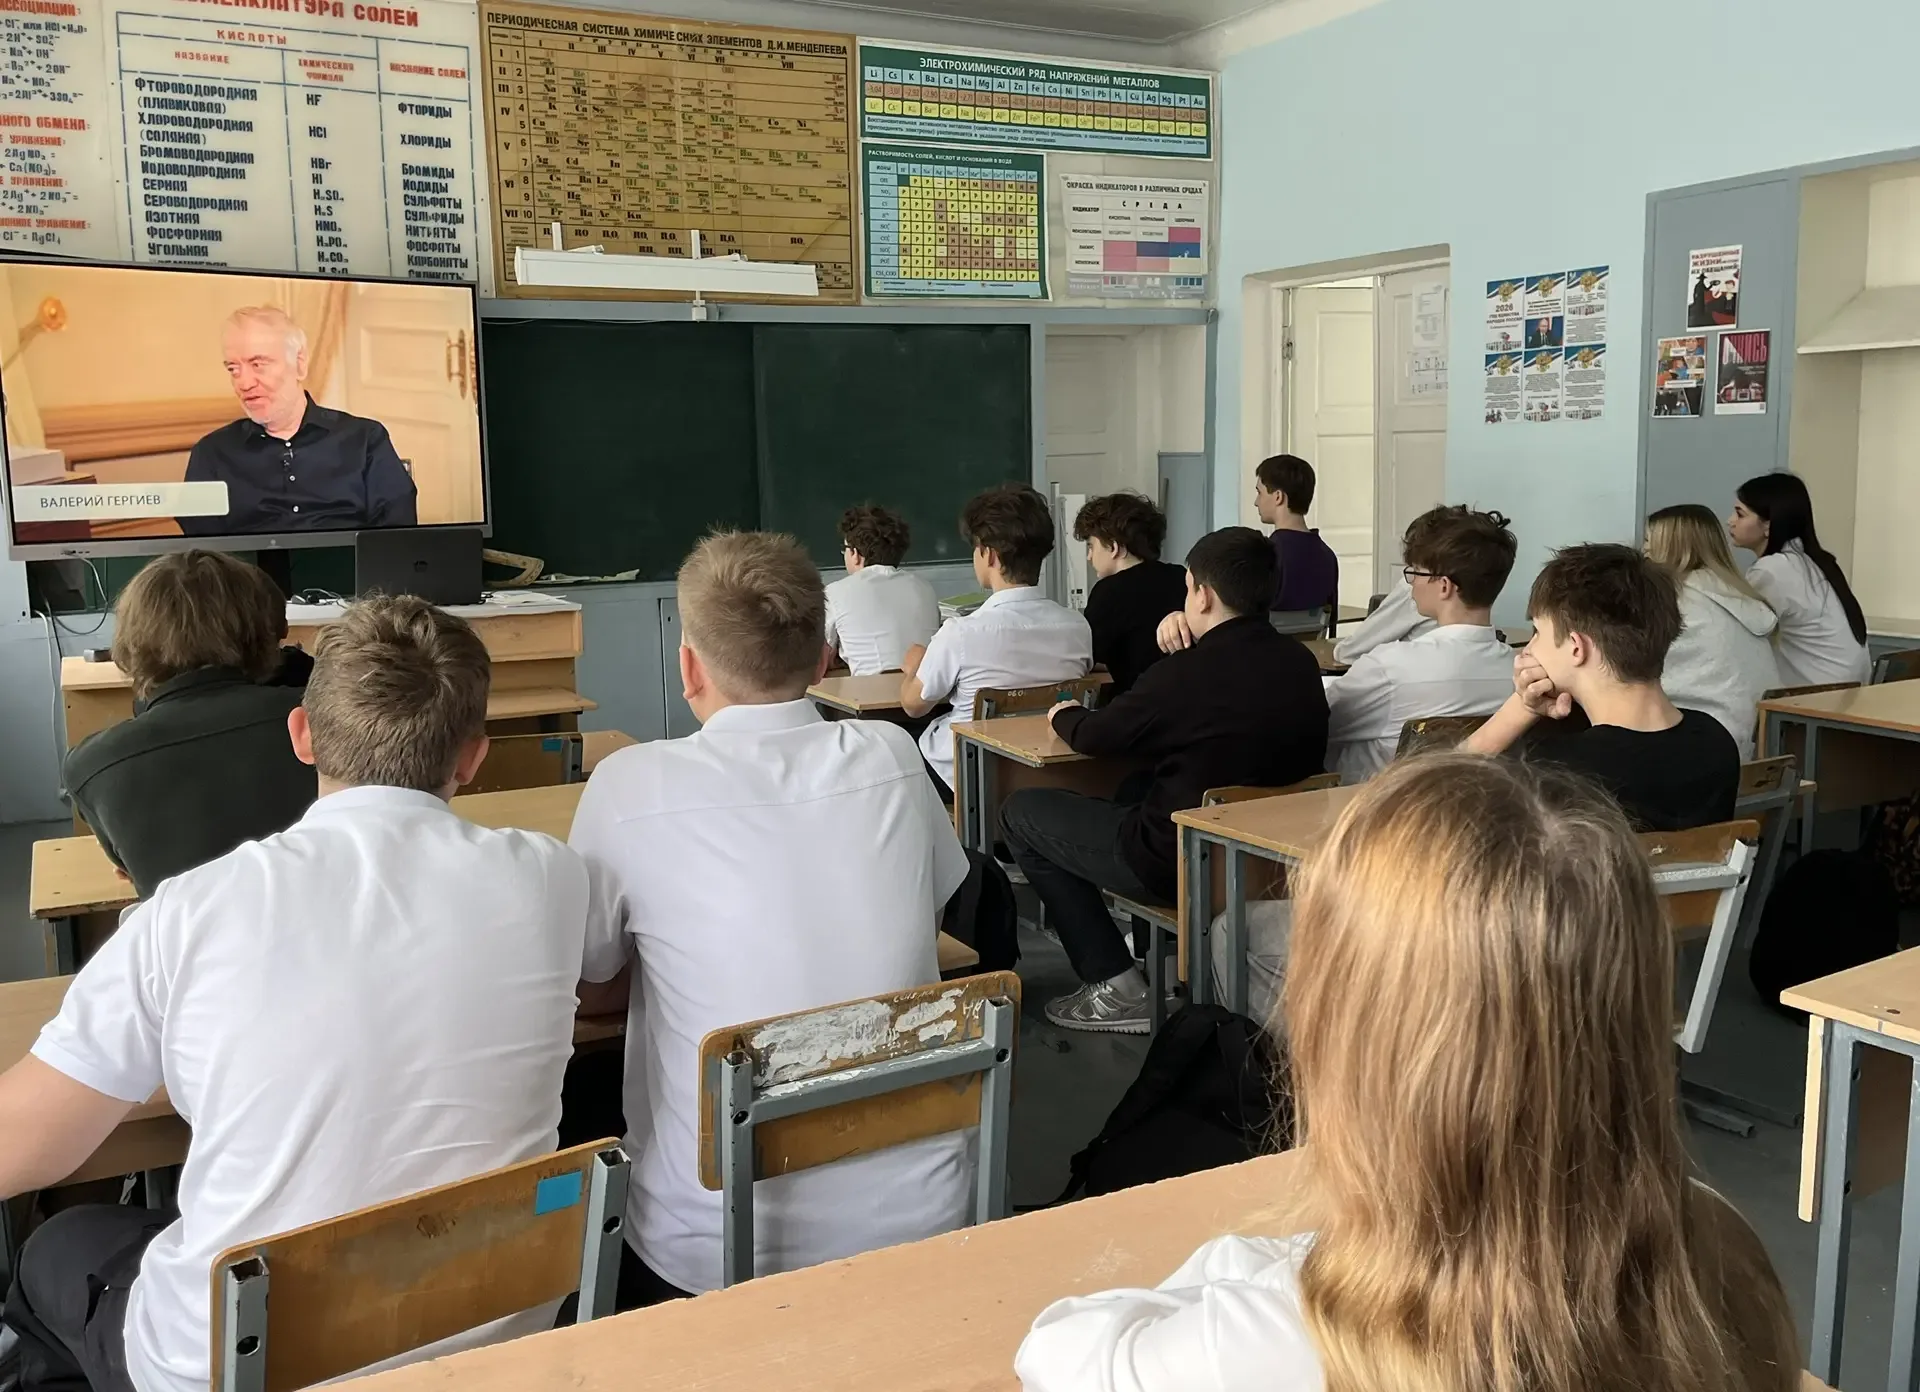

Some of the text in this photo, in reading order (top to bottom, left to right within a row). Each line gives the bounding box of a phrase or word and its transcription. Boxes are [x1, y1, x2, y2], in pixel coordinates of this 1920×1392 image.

[353, 4, 419, 27] СОЛЕЙ
[217, 30, 287, 45] КИСЛОТЫ
[582, 22, 630, 37] СИСТЕМА
[706, 34, 762, 49] ЭЛЕМЕНТОВ
[174, 51, 230, 64] НАЗВАНИЕ
[390, 62, 467, 79] НАЗВАНИЕ СОЛЕЙ
[515, 67, 523, 77] 2
[919, 57, 1160, 88] ЭЛЕКТРОХИМИЧЕСКИЙ РЯД НАПРЯЖЕНИЙ МЕТАЛЛОВ
[135, 77, 258, 101] ФТОРОВОДОРОДНАЯ
[517, 84, 524, 94] 3
[870, 69, 878, 78] Li
[888, 71, 898, 80] Cs
[908, 72, 915, 81] K
[925, 74, 935, 83] Ba
[943, 76, 953, 85] Ca
[961, 77, 972, 86] Na
[978, 79, 990, 89] Mg
[997, 81, 1006, 89] Al
[1014, 82, 1023, 90] Zn
[1031, 84, 1040, 92] Fe
[1048, 85, 1058, 94] Co
[1065, 87, 1073, 95] Ni
[1081, 88, 1090, 96] Sn
[1097, 90, 1107, 98] Pb
[1130, 92, 1140, 101] Cu
[1146, 94, 1157, 104] Ag
[1162, 95, 1172, 105] Hg
[1179, 96, 1186, 104] Pt
[1193, 97, 1204, 106] Au
[137, 96, 226, 114] (ПЛАВИКОВАЯ)
[306, 93, 322, 106] HF
[398, 102, 452, 119] ФТОРИДЫ
[518, 103, 525, 113] 4
[0, 114, 31, 127] НОГО
[138, 112, 254, 132] ХЛОРОВОДОРОДНАЯ
[519, 120, 526, 129] 5
[140, 130, 206, 145] (СОЛЯНАЯ)
[309, 125, 327, 139] HCl
[400, 133, 452, 149] ХЛОРИДЫ
[520, 138, 527, 147] 6
[140, 144, 254, 164] БРОМОВОДОРОДНАЯ
[868, 149, 914, 159] РАСТВОРИМОСТЬ
[311, 157, 332, 170] HBr
[402, 163, 455, 179] БРОМИДЫ
[142, 177, 188, 192] СЕРНАЯ
[402, 178, 449, 194] ИОДИДЫ
[522, 176, 529, 185] 8
[1066, 181, 1094, 190] ОКРАСКА
[1095, 183, 1138, 192] ИНДИКАТОРОВ
[1144, 185, 1180, 194] РАЗЛИЧНЫХ
[144, 193, 248, 211] СЕРОВОДОРОДНАЯ
[403, 193, 462, 210] СУЛЬФАТЫ
[523, 192, 530, 202] 9
[145, 210, 200, 225] АЗОТНАЯ
[404, 209, 465, 225] СУЛЬФИДЫ
[523, 209, 532, 219] 10
[146, 226, 222, 242] ФОСФОРНАЯ
[405, 224, 457, 239] НИТРАТЫ
[148, 242, 209, 257] УГОЛЬНАЯ
[406, 239, 461, 254] ФОСФАТЫ
[407, 254, 469, 269] КАРБОНАТЫ
[40, 494, 161, 508] ВАЛЕРИЙ ГЕРГИЕВ
